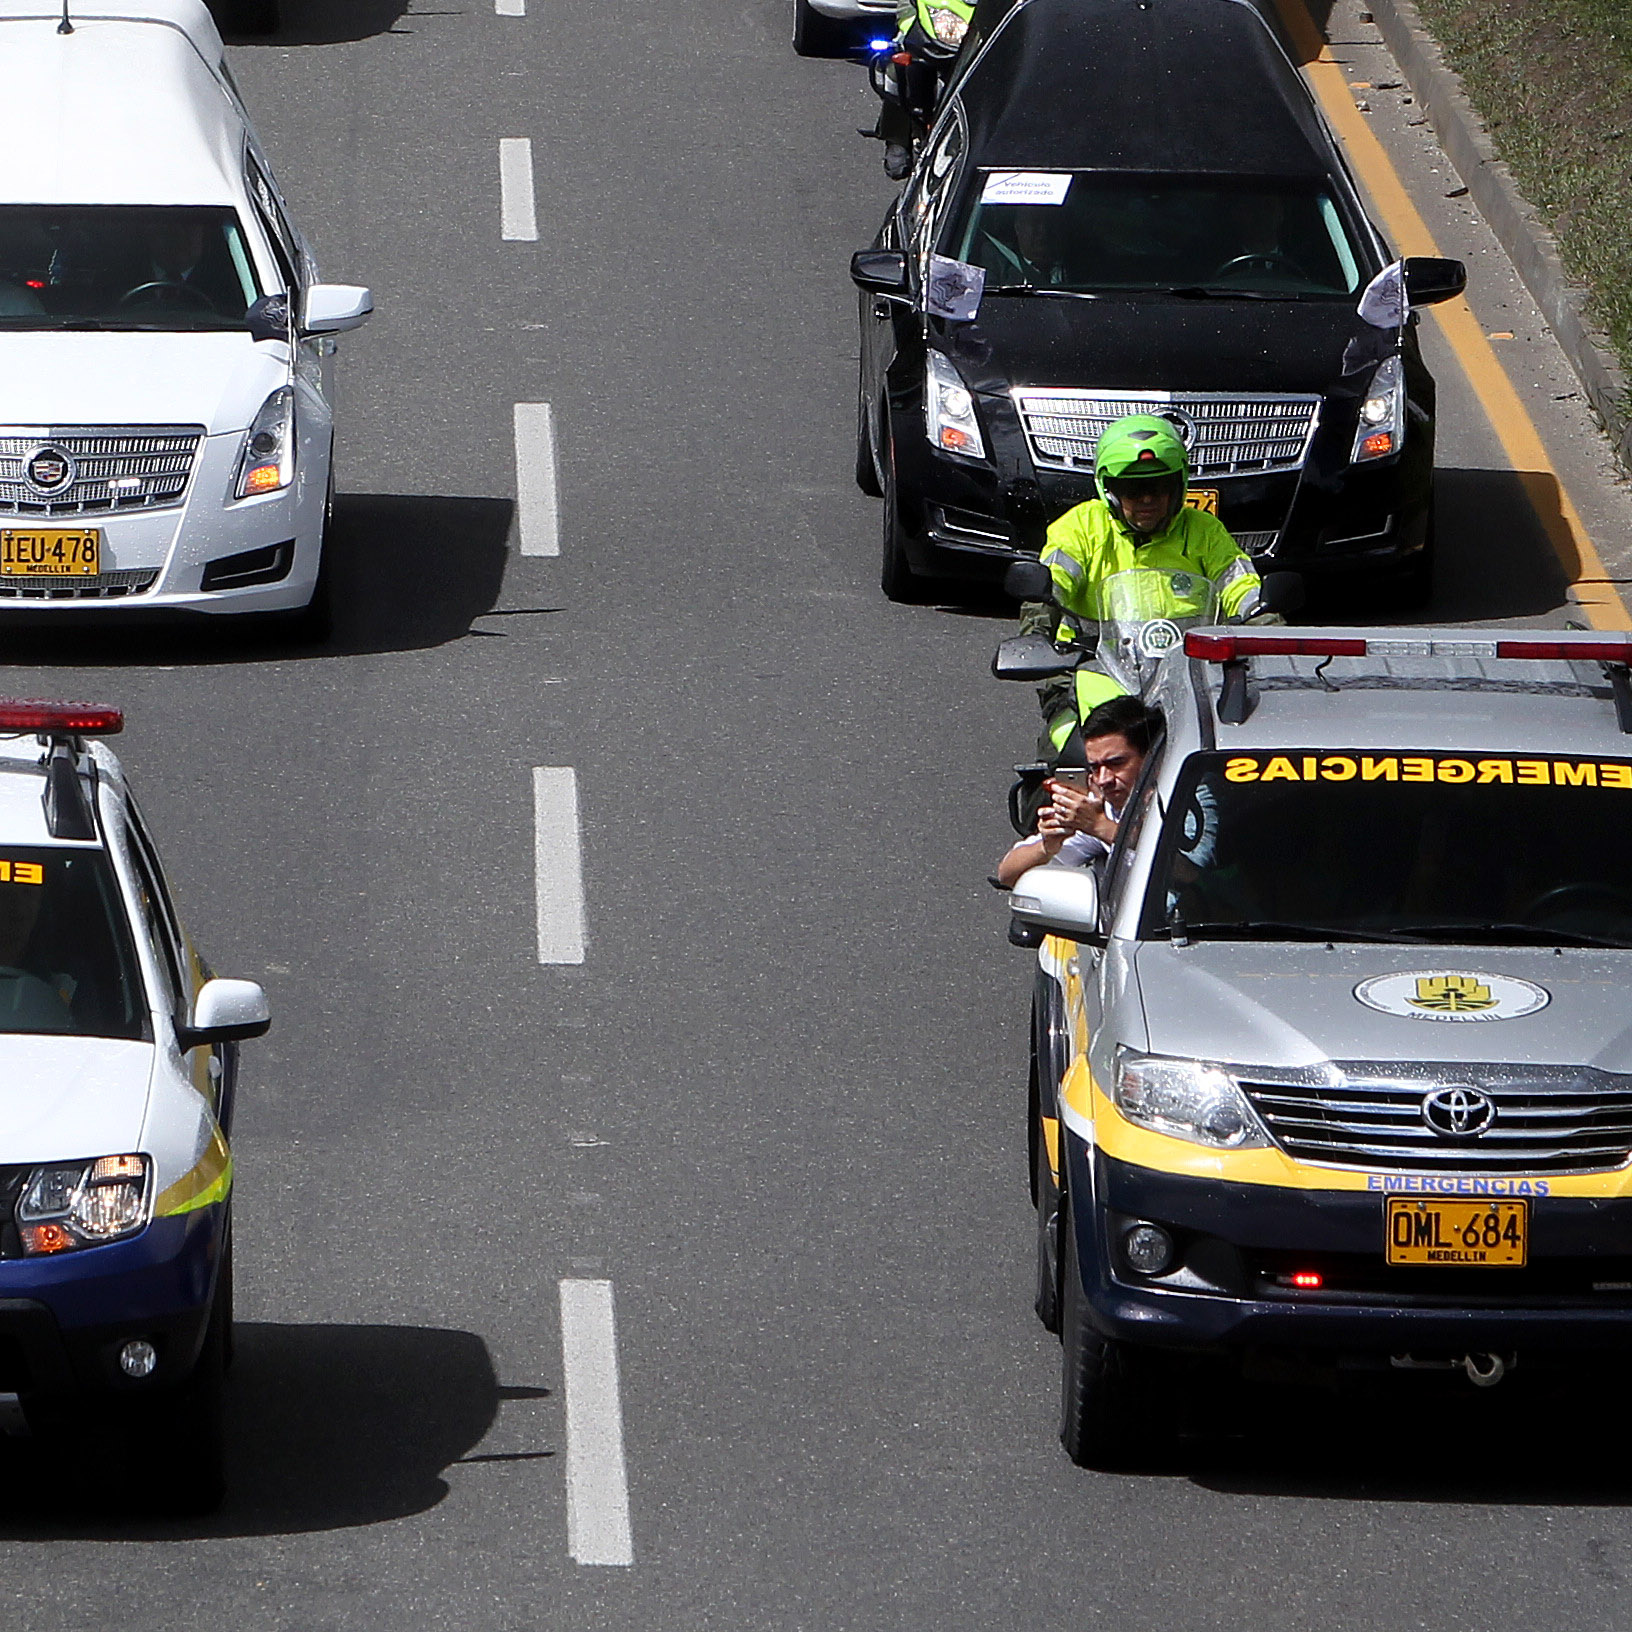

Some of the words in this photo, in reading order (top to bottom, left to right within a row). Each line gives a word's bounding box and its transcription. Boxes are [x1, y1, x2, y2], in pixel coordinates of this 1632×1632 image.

[3, 537, 95, 563] IEU-478
[26, 564, 72, 573] MEDELLIN
[1368, 1175, 1550, 1197] EMERGENCIAS
[1393, 1211, 1521, 1248] OML-684
[1427, 1250, 1487, 1262] MEDELLIN
